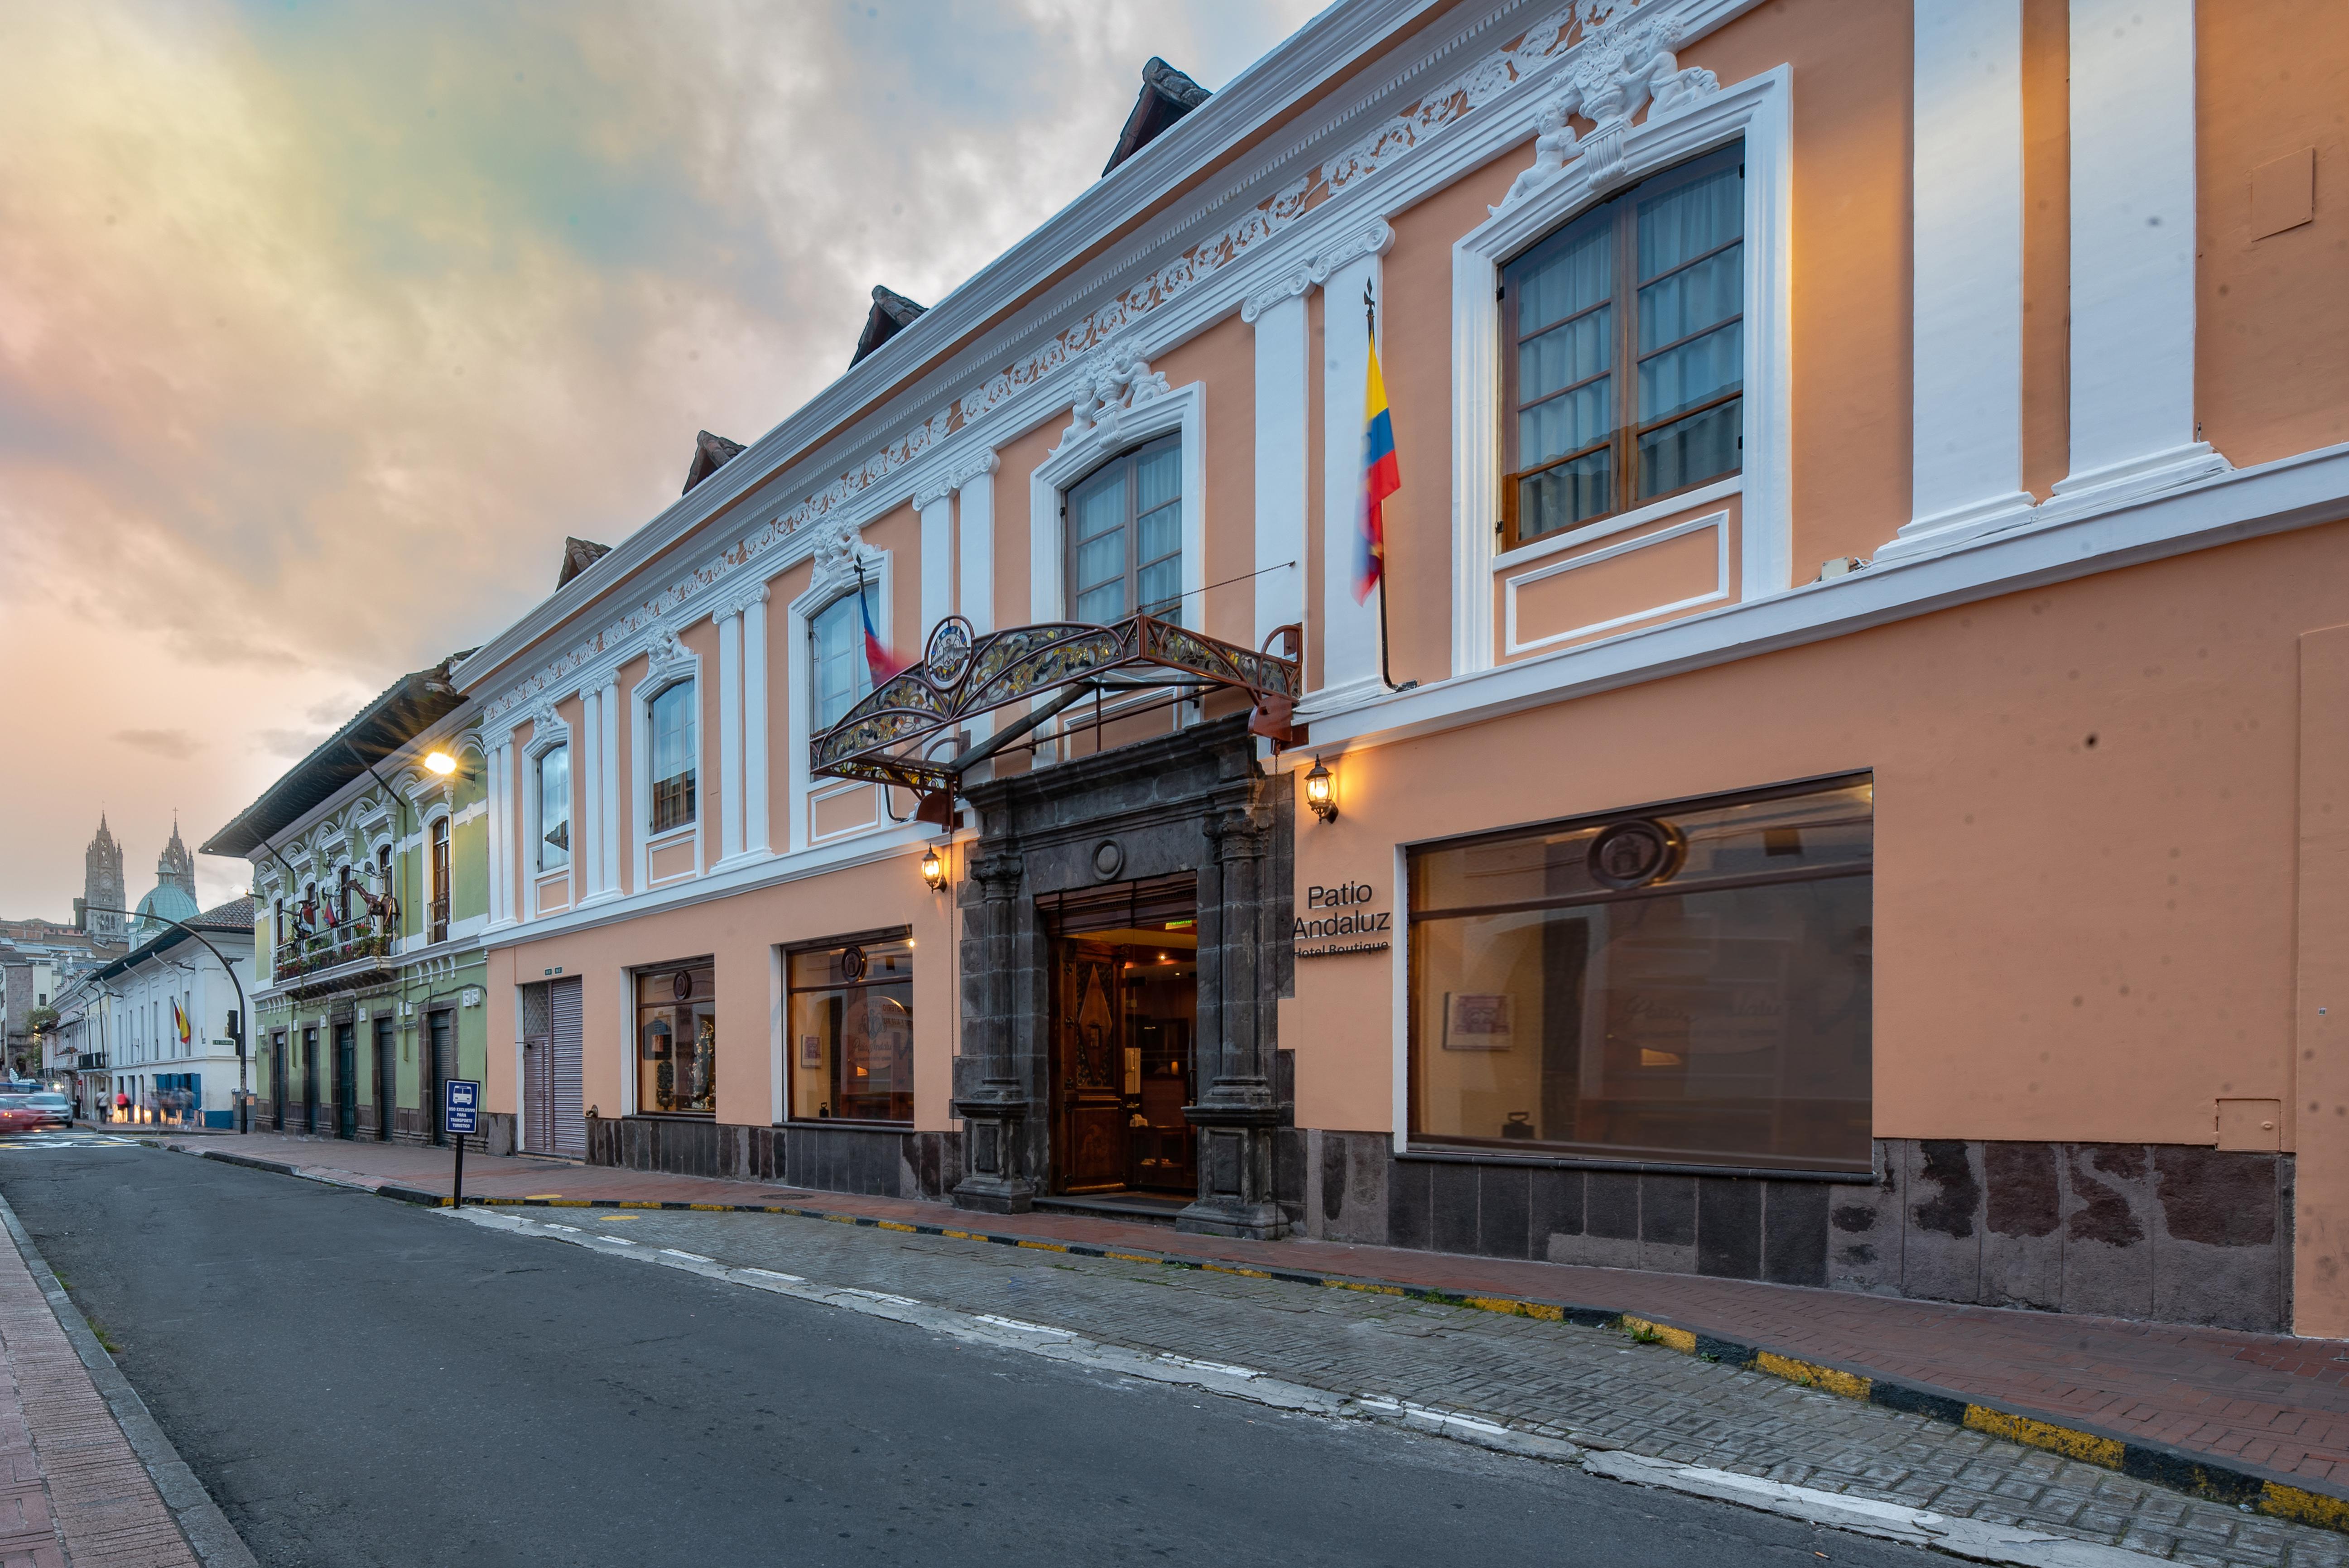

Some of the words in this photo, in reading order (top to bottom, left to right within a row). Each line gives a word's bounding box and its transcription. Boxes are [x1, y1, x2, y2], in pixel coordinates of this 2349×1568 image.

[1308, 880, 1372, 909] Patio
[1291, 910, 1391, 940] Andaluz
[1294, 945, 1325, 958] Hotel
[1329, 941, 1391, 955] Boutique
